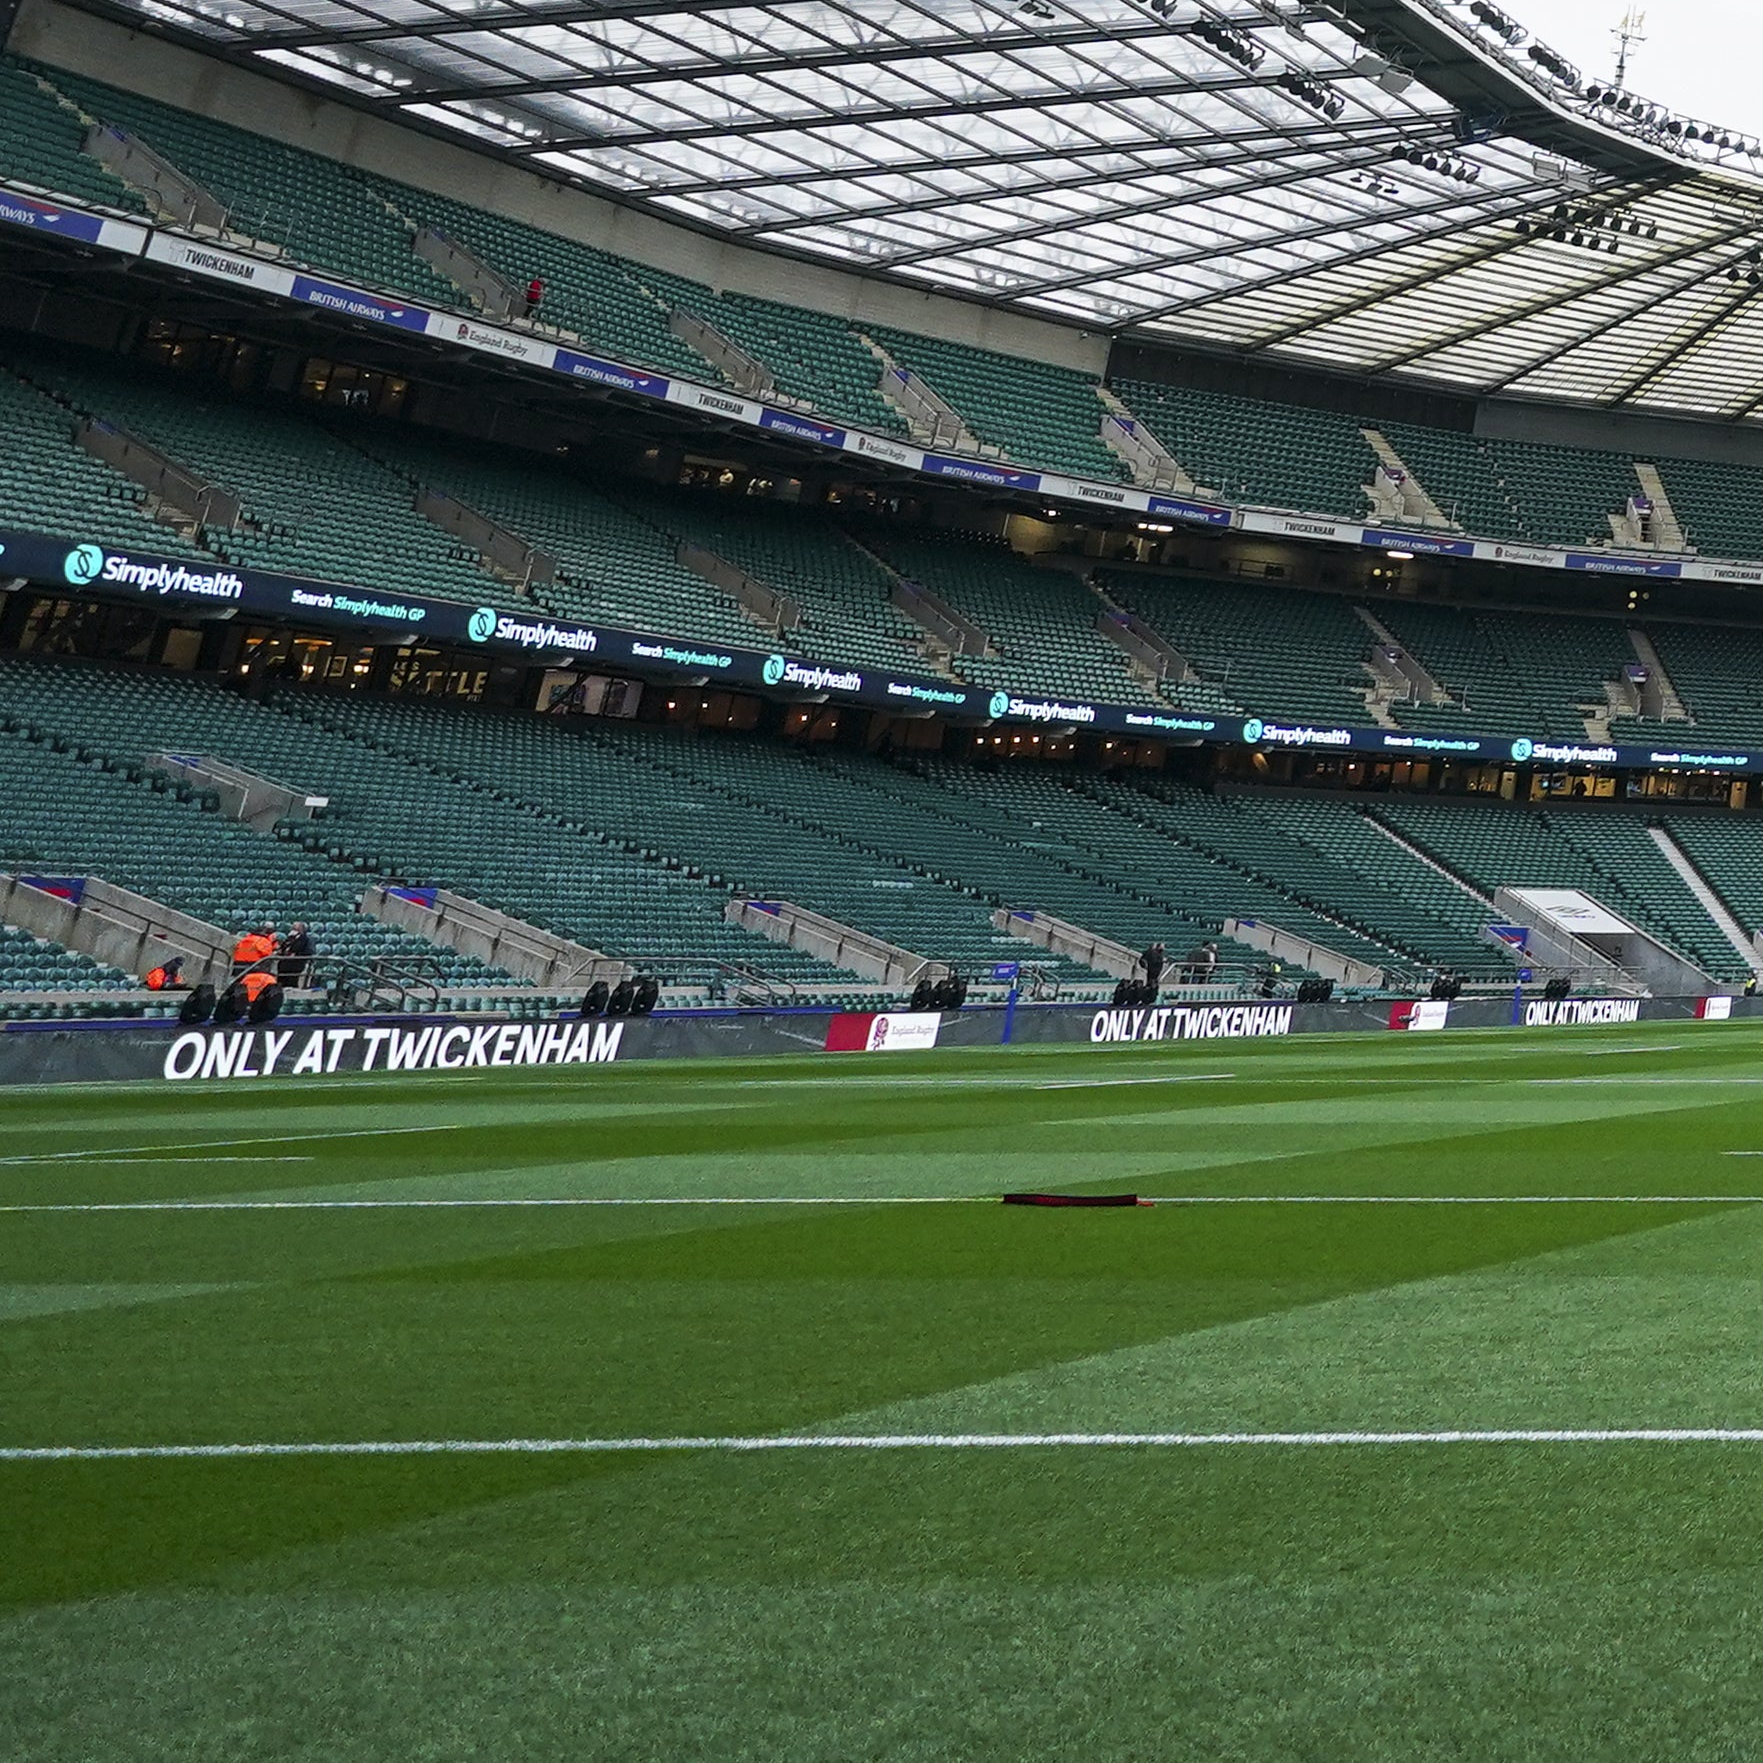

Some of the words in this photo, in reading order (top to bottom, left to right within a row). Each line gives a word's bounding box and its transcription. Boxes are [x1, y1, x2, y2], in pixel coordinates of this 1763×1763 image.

[184, 248, 254, 280] TWICKENHAM
[309, 290, 348, 311] BRITISH
[348, 301, 384, 320] AIRWAYS
[470, 331, 500, 348] England
[501, 338, 528, 356] Rugby
[573, 365, 603, 382] BRITISH
[603, 372, 634, 388] AIRWAYS
[699, 392, 744, 415] TWICKENHAM
[1078, 485, 1124, 502] TWICKENHAM
[1284, 522, 1335, 536] TWICKENHAM
[1381, 539, 1409, 550] BRITISH
[1409, 542, 1440, 552] AIRWAYS
[1504, 549, 1530, 561] England
[1531, 553, 1553, 564] Rugby
[102, 556, 243, 599] Simplyhealth
[1713, 569, 1762, 580] TWICKENHAM
[292, 589, 333, 609] Search
[333, 596, 407, 620] Simplyhealth
[408, 607, 425, 622] GP
[495, 618, 597, 652] Simplyhealth
[632, 643, 663, 658] Search
[663, 648, 718, 666] Simplyhealth
[719, 656, 732, 667] GP
[784, 663, 861, 691] Simplyhealth
[1008, 699, 1095, 722] Simplyhealth
[1262, 725, 1351, 745] Simplyhealth
[1532, 744, 1618, 762] Simplyhealth
[1090, 1009, 1144, 1043] ONLY
[1144, 1009, 1173, 1039] AT
[1173, 1006, 1292, 1039] TWICKENHAM
[1526, 1001, 1553, 1025] ONLY
[1555, 1001, 1570, 1024] AT
[1570, 1000, 1639, 1024] TWICKENHAM
[164, 1030, 294, 1080] ONLY
[293, 1029, 355, 1074] AT
[363, 1023, 624, 1072] TWICKENHAM
